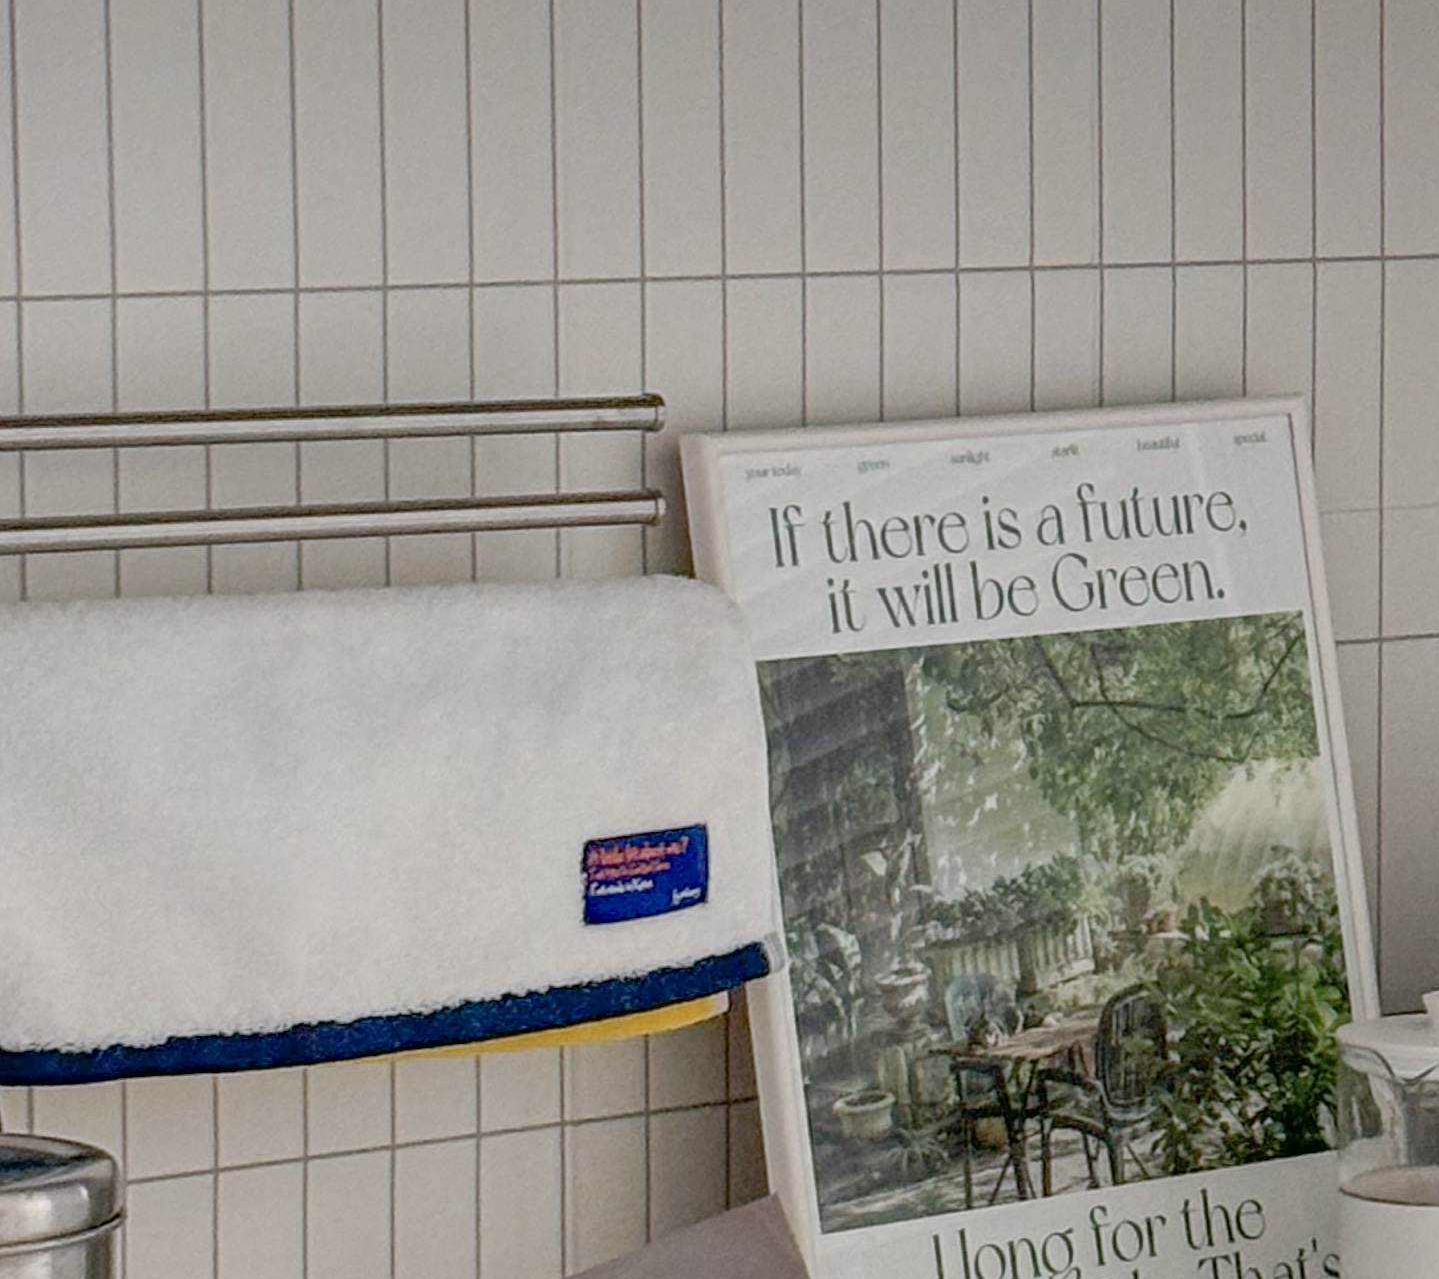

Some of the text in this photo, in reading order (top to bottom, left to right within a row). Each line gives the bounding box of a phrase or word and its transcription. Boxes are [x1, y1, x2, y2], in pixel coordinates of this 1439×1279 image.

[769, 482, 1248, 568] If there is a future,
[826, 552, 1226, 634] it will be Green.
[1089, 1205, 1168, 1267] for
[1180, 1187, 1267, 1251] the
